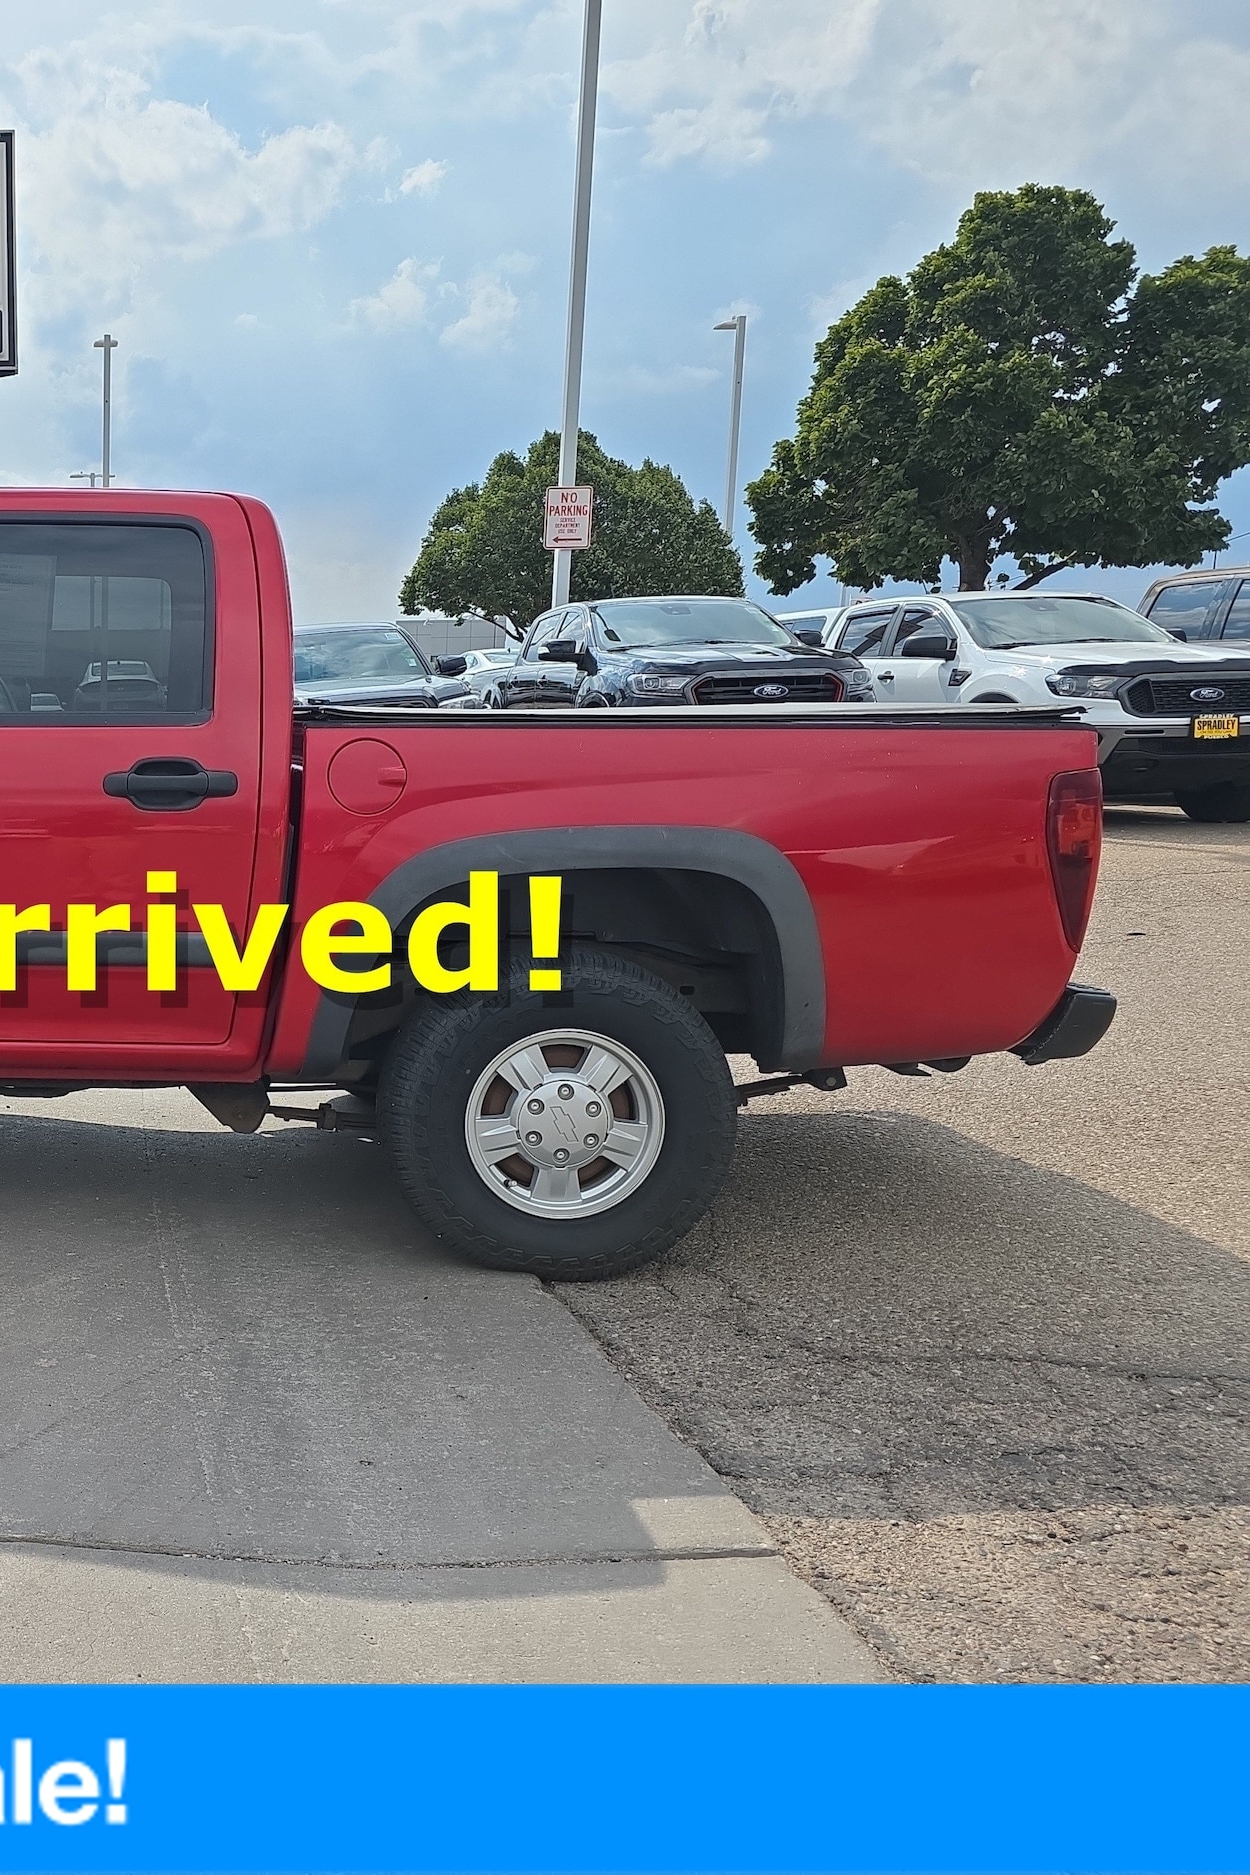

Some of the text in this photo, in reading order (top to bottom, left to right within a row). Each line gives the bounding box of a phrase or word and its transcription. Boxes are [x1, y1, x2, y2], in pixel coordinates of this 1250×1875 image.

[560, 492, 578, 504] NO
[549, 504, 588, 517] PARKING
[1197, 720, 1236, 730] SPRADLEY
